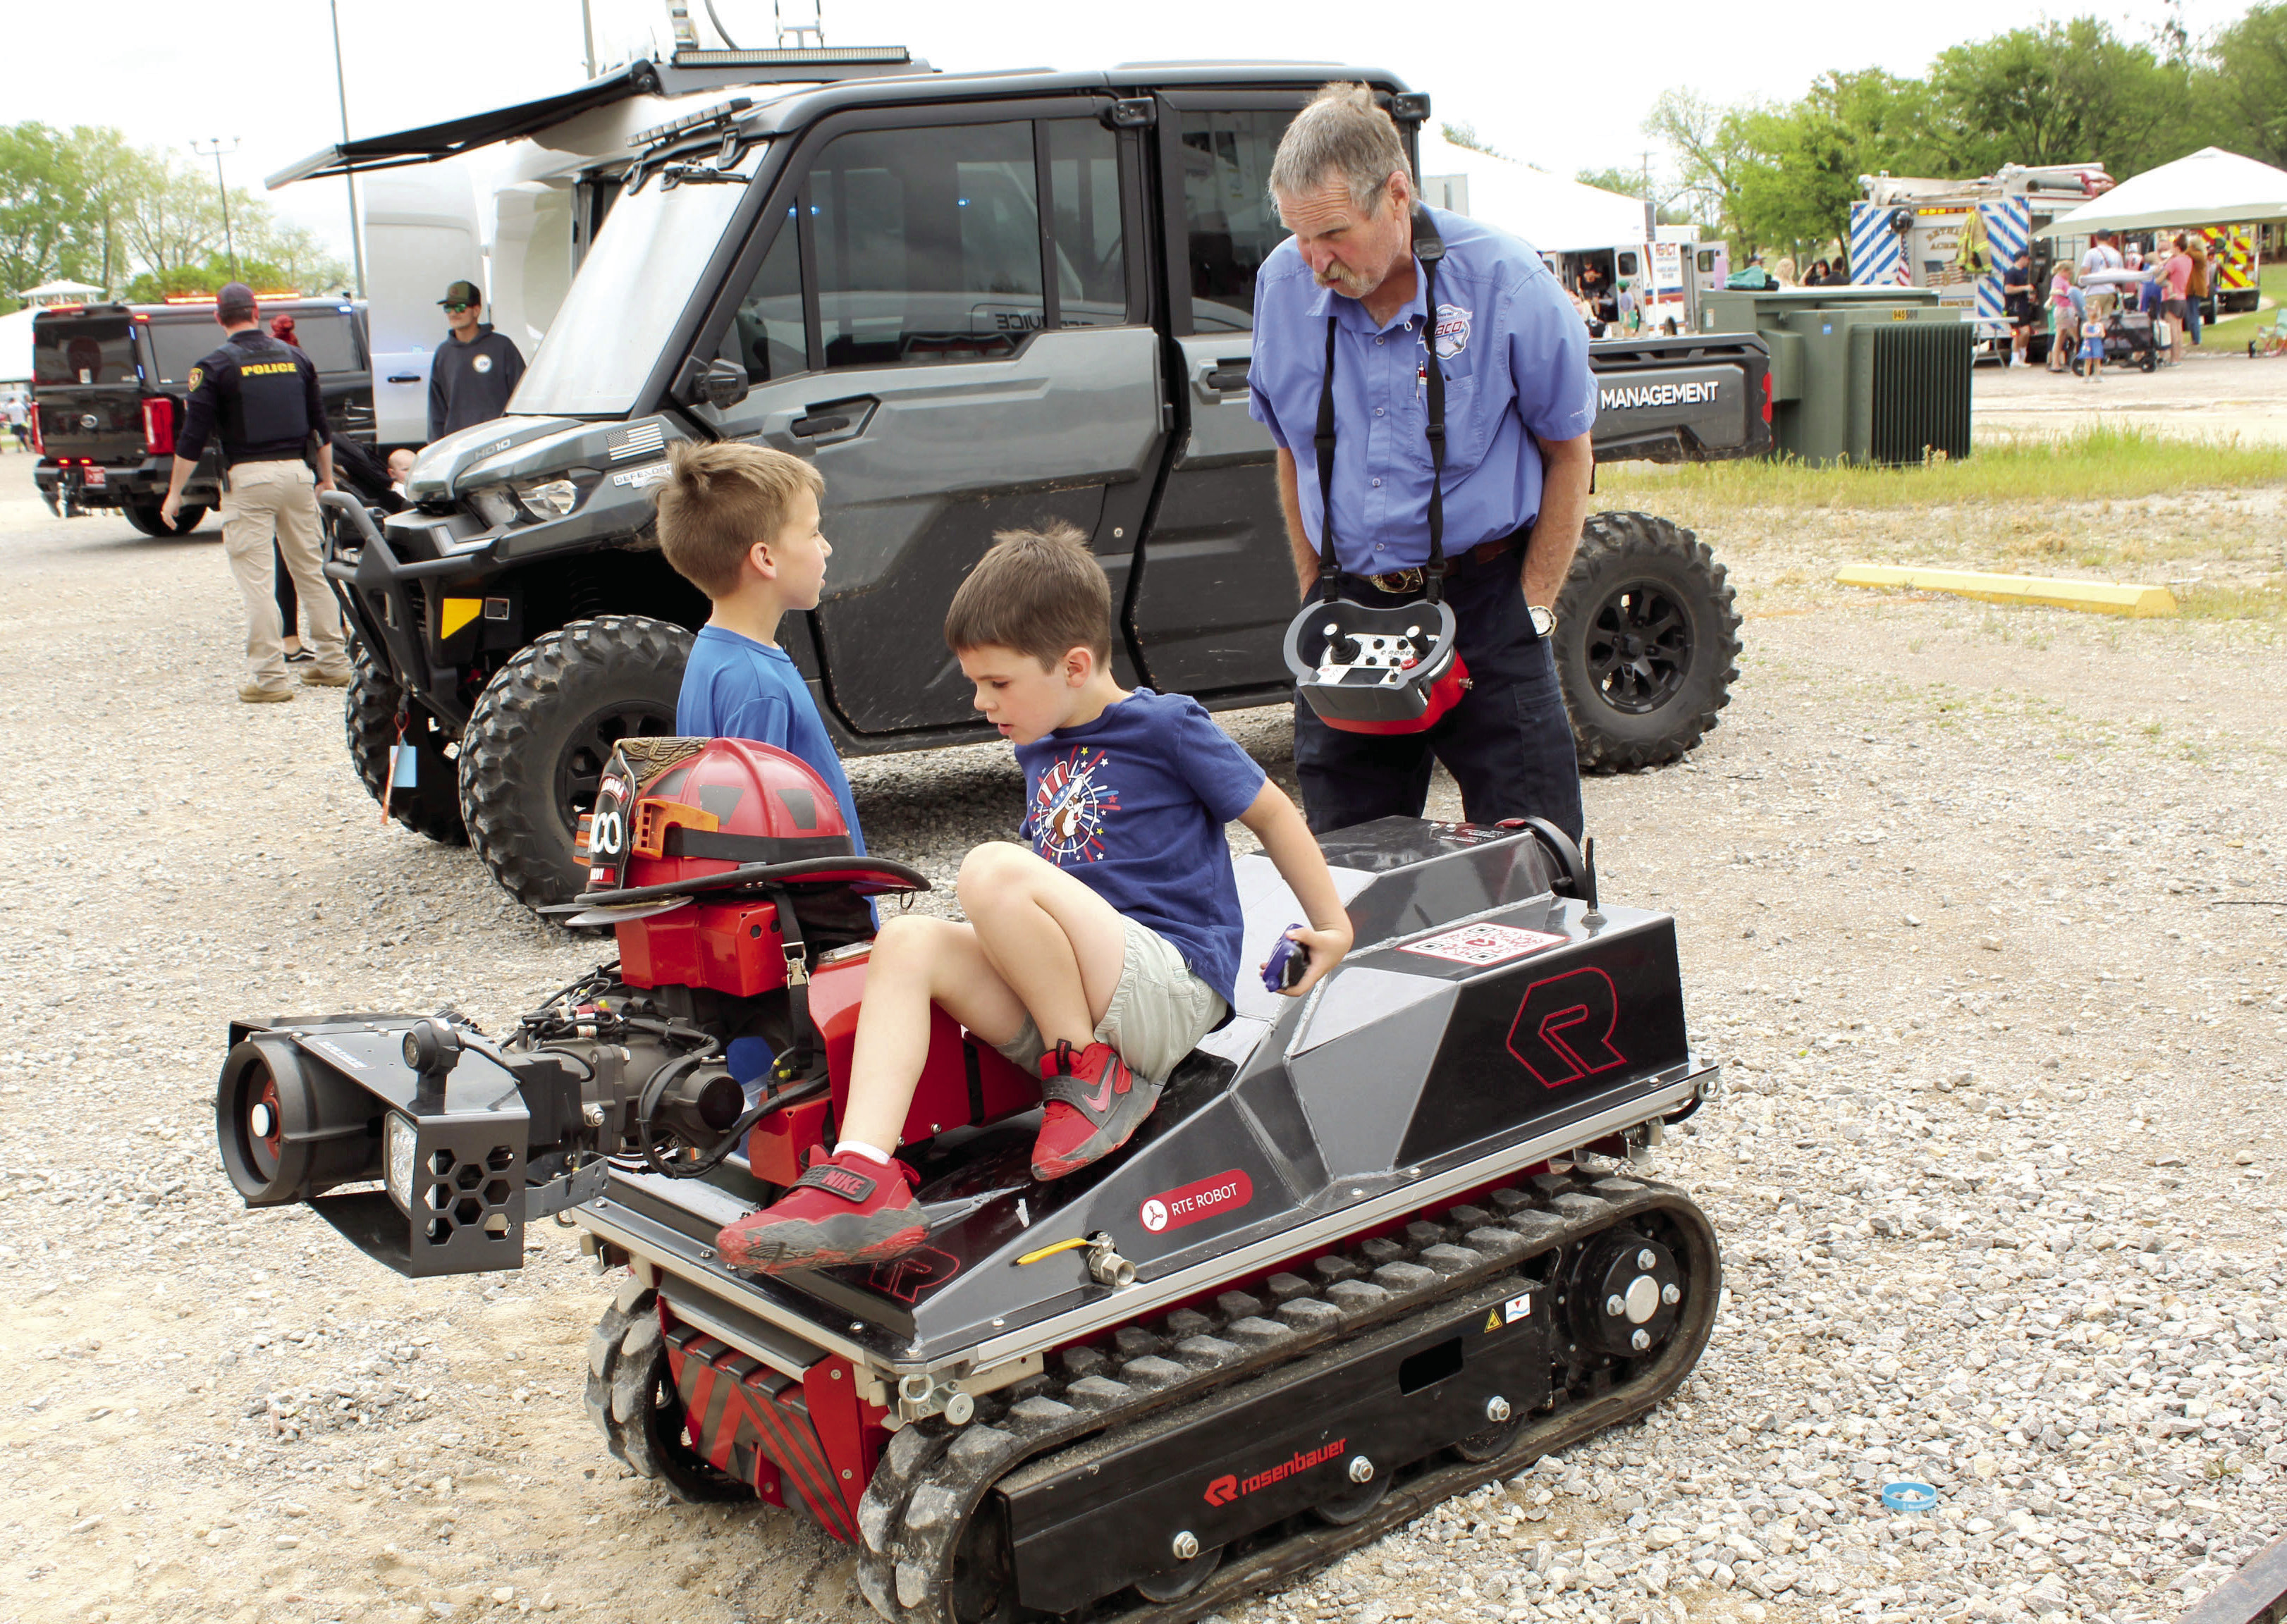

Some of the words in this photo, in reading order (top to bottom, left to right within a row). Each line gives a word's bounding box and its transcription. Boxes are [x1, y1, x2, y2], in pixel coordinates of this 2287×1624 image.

[1434, 321, 1463, 336] aco
[240, 362, 297, 376] POLICE
[1600, 381, 1719, 410] MANAGEMENT
[821, 1171, 865, 1195] NIKE
[1171, 1198, 1194, 1216] RTE
[1196, 1183, 1237, 1207] ROBOT
[1241, 1438, 1347, 1495] rosenbauer
